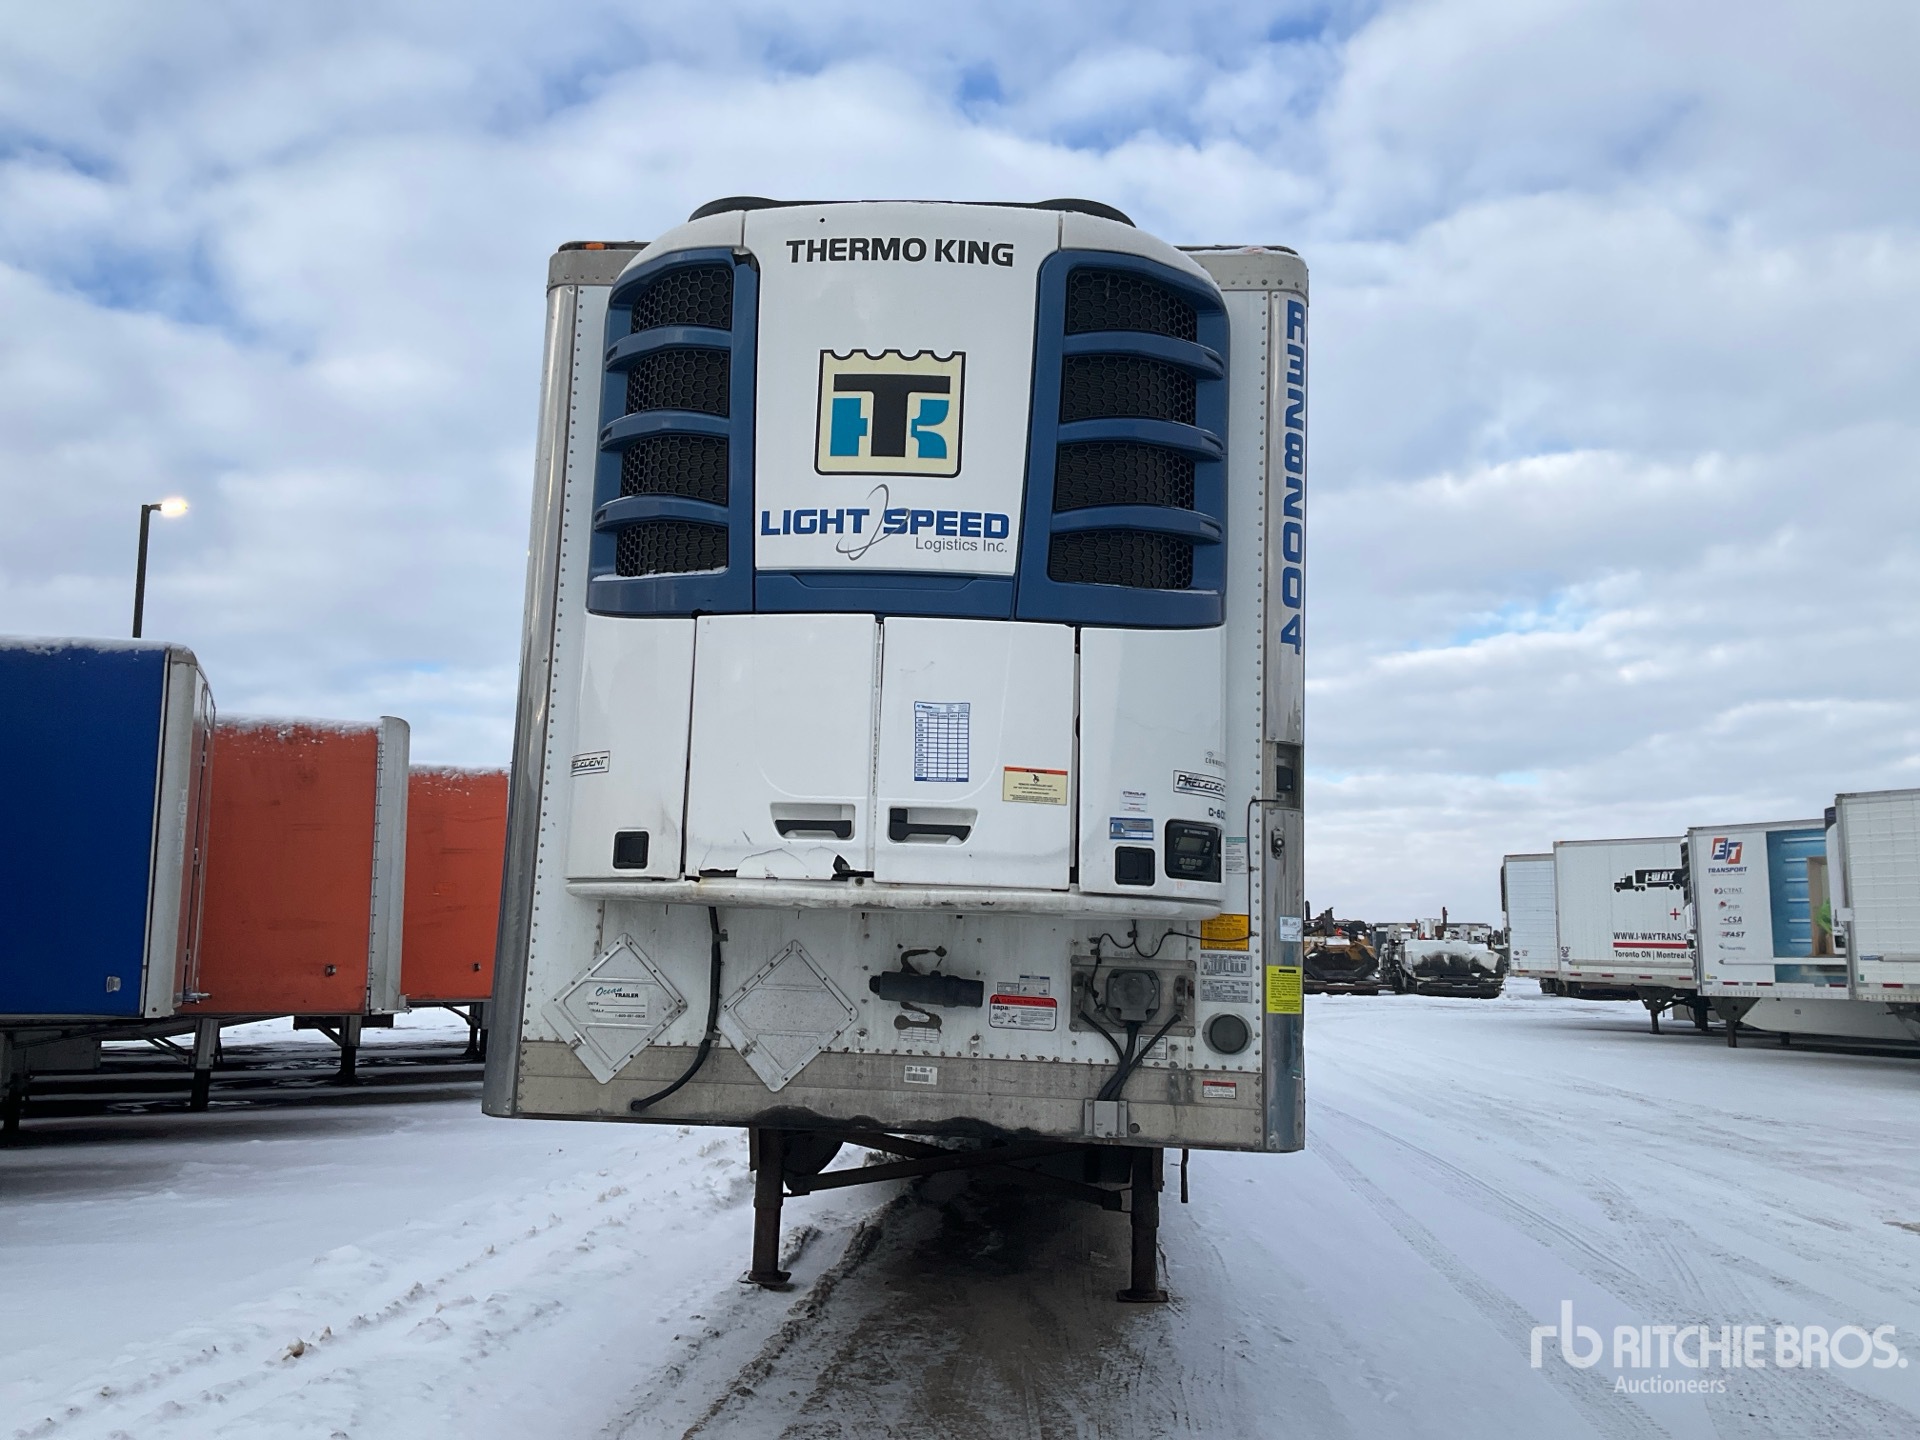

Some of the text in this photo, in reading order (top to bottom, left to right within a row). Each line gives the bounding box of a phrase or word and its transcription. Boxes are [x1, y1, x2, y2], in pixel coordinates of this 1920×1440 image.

[786, 238, 1014, 267] THERMO KING
[761, 507, 1009, 539] LIGHT SPEED
[915, 537, 1008, 553] Logistics Inc.
[1614, 950, 1687, 959] Toronto ON Montreal
[595, 986, 623, 997] Ocean
